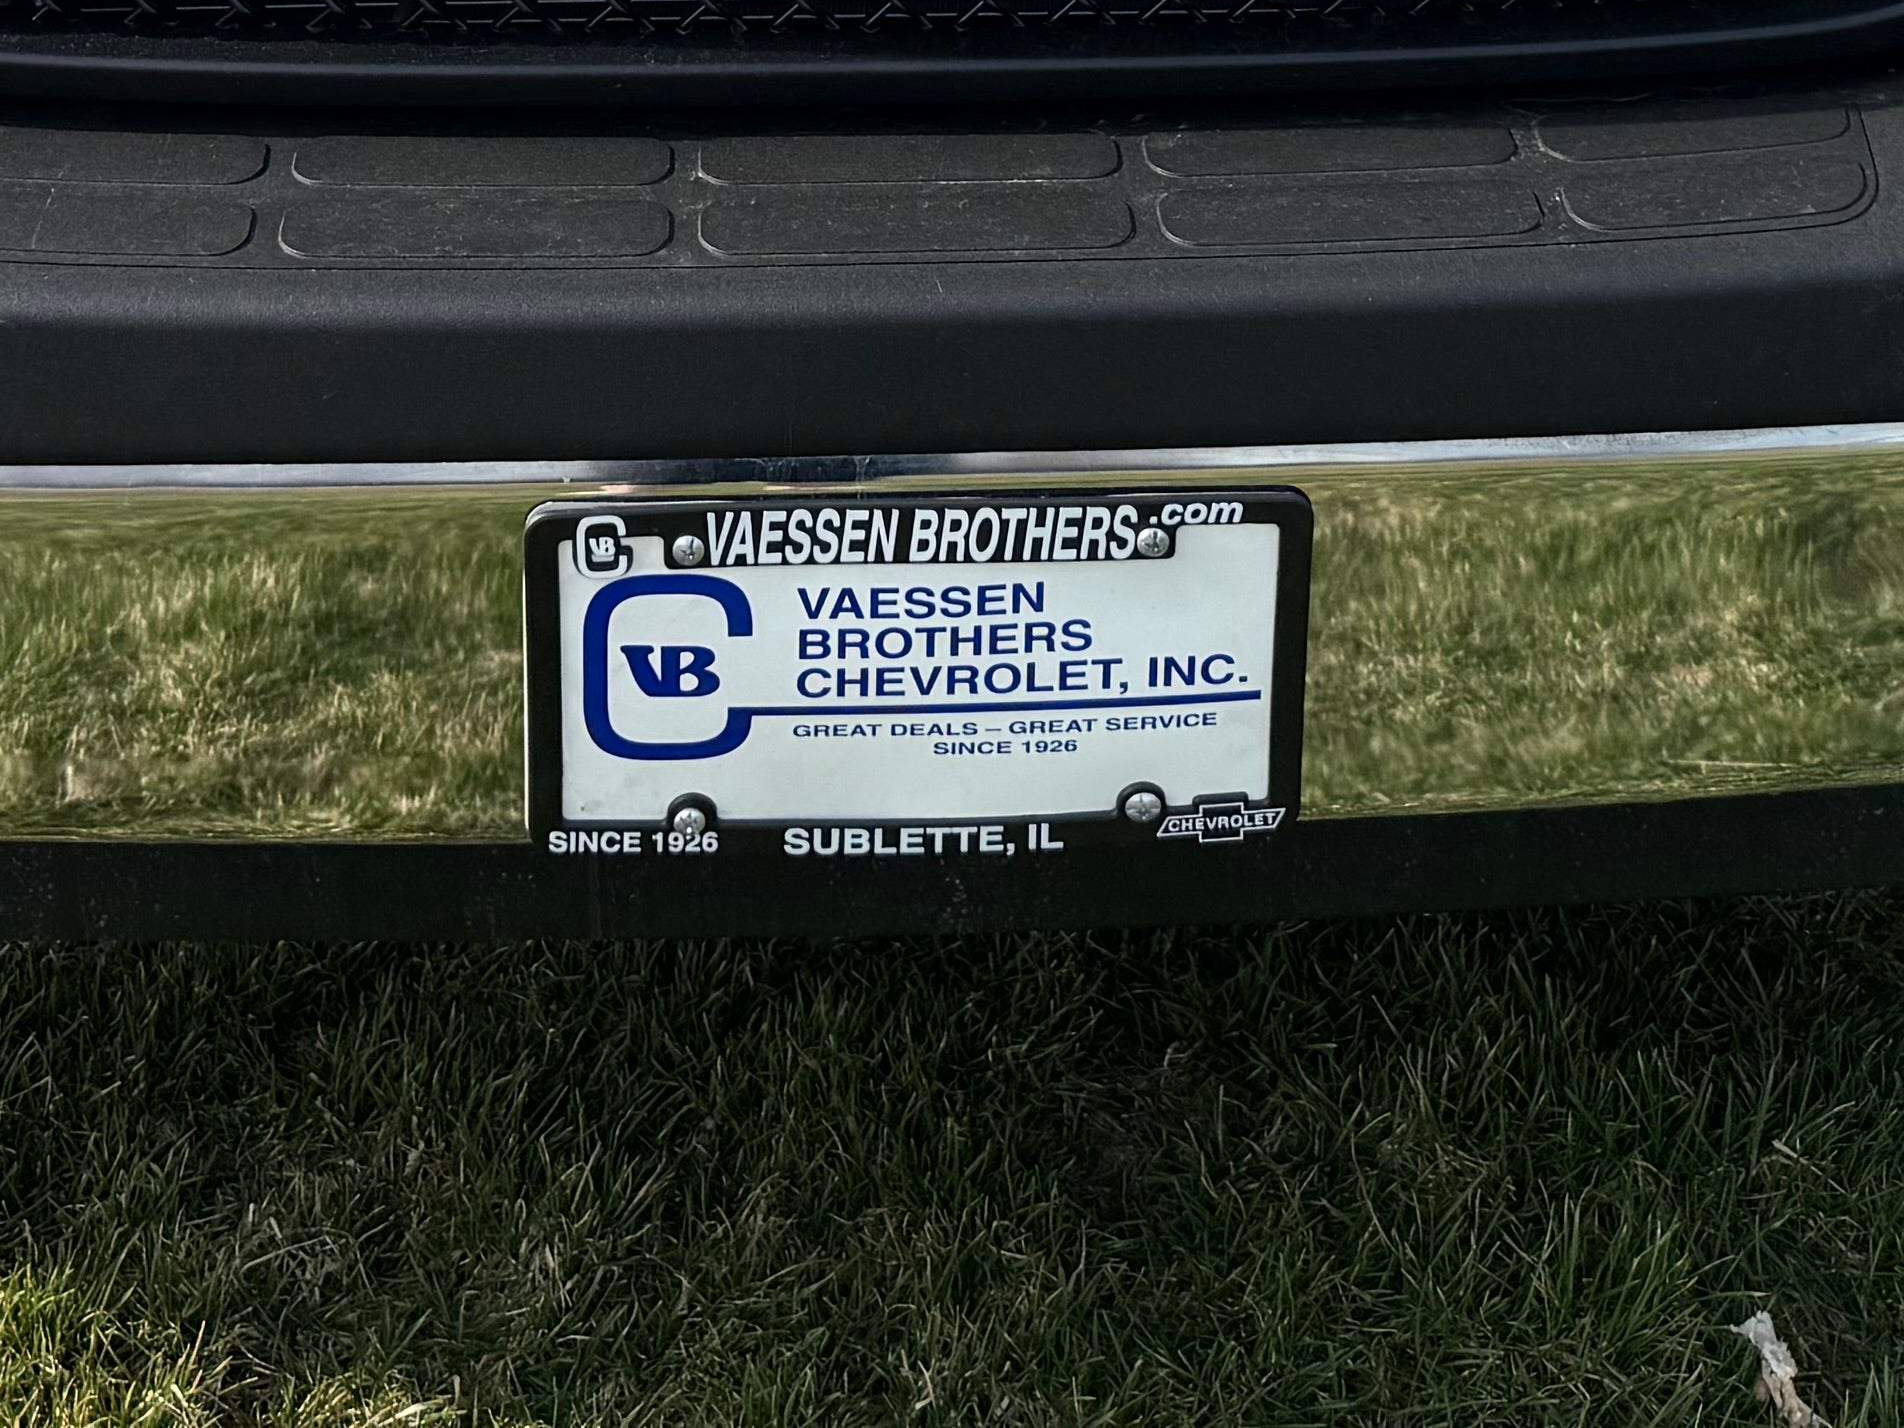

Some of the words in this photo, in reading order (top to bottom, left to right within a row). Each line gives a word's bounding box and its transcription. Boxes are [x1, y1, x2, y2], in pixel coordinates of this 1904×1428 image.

[706, 507, 900, 566] VAESSEN
[797, 581, 1045, 620] VAESSEN
[798, 619, 1093, 660] BROTHERS
[796, 657, 1129, 698] CHEVROLET,
[1148, 653, 1249, 688] INC.
[793, 723, 883, 737] GREAT
[891, 721, 979, 736] DEALS
[1008, 718, 1099, 735] GREAT
[1105, 712, 1218, 732] SERVICE
[933, 741, 1013, 756] SINCE
[1024, 739, 1078, 754] 1926
[1167, 812, 1277, 833] CHEVROLET
[548, 830, 642, 854] SINCE
[652, 830, 719, 854] 1926
[783, 825, 1016, 856] SUBLETTE,
[1027, 823, 1064, 854] IL
